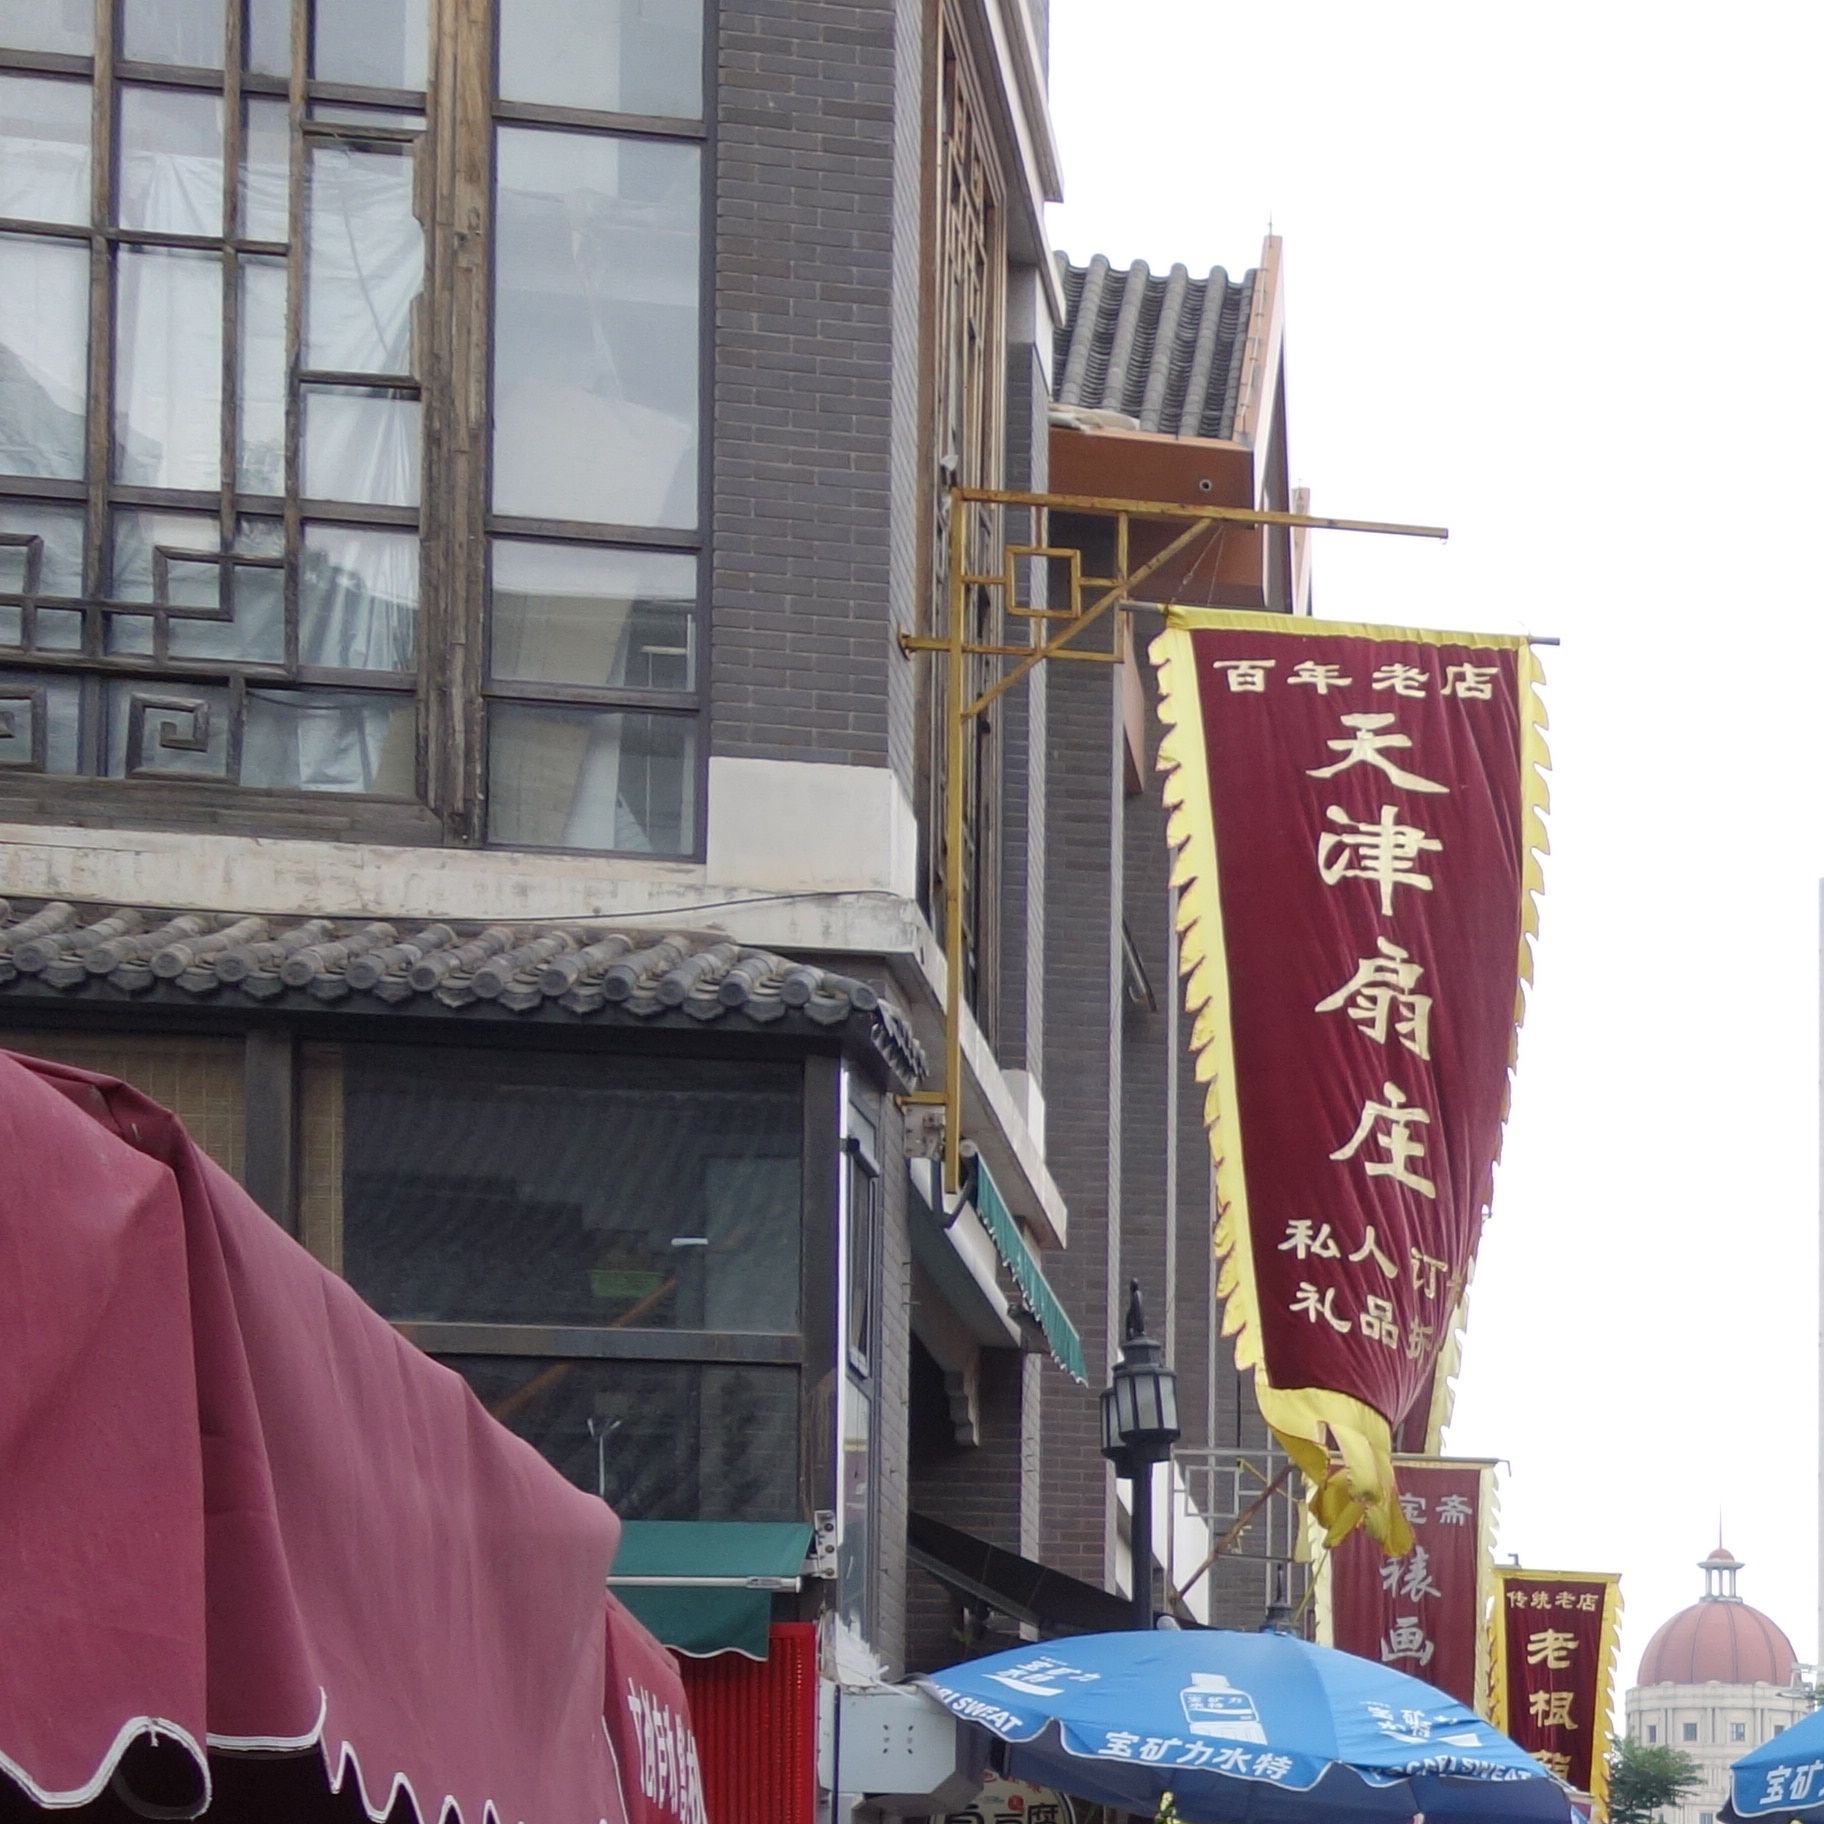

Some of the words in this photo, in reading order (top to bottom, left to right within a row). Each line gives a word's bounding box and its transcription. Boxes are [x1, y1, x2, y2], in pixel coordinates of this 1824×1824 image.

[1213, 659, 1499, 700] 百年老店
[1306, 711, 1451, 1200] 天津扇庄
[1379, 1546, 1442, 1666] 裱画
[1507, 1590, 1600, 1611] 传统老店
[1097, 1730, 1294, 1781] 宝矿力水特
